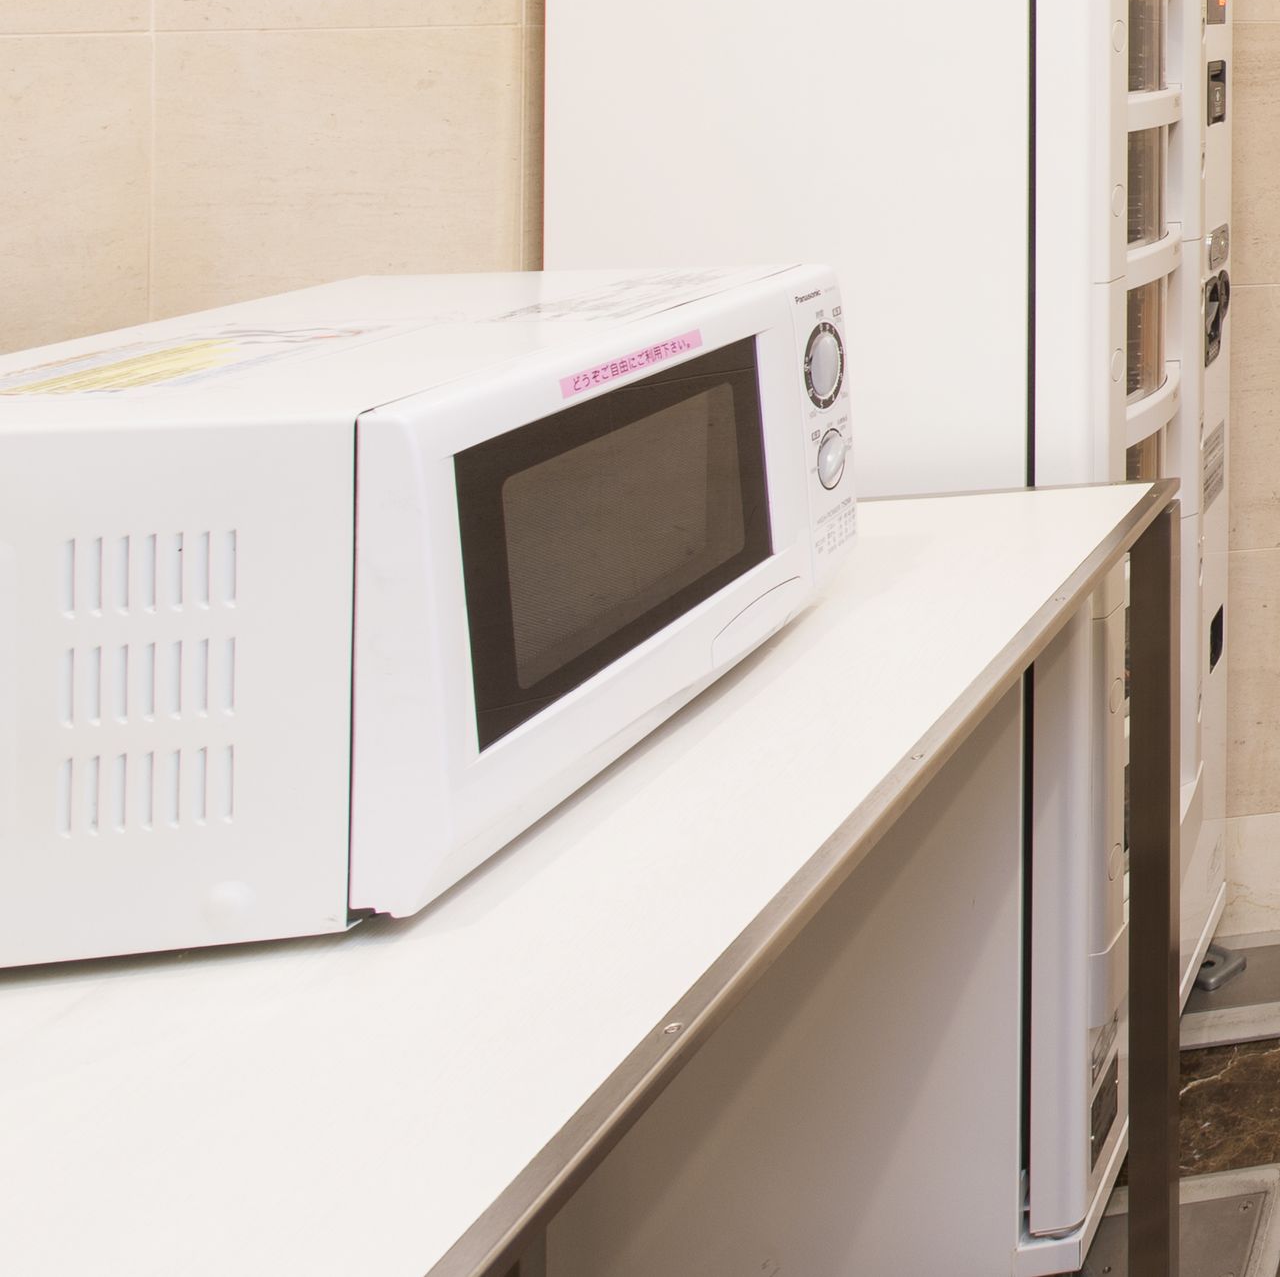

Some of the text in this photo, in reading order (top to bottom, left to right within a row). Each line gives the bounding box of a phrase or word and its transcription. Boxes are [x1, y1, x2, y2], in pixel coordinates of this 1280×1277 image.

[794, 289, 822, 305] Panasonic
[573, 338, 692, 392] どうぞご自由にご利用下さい。
